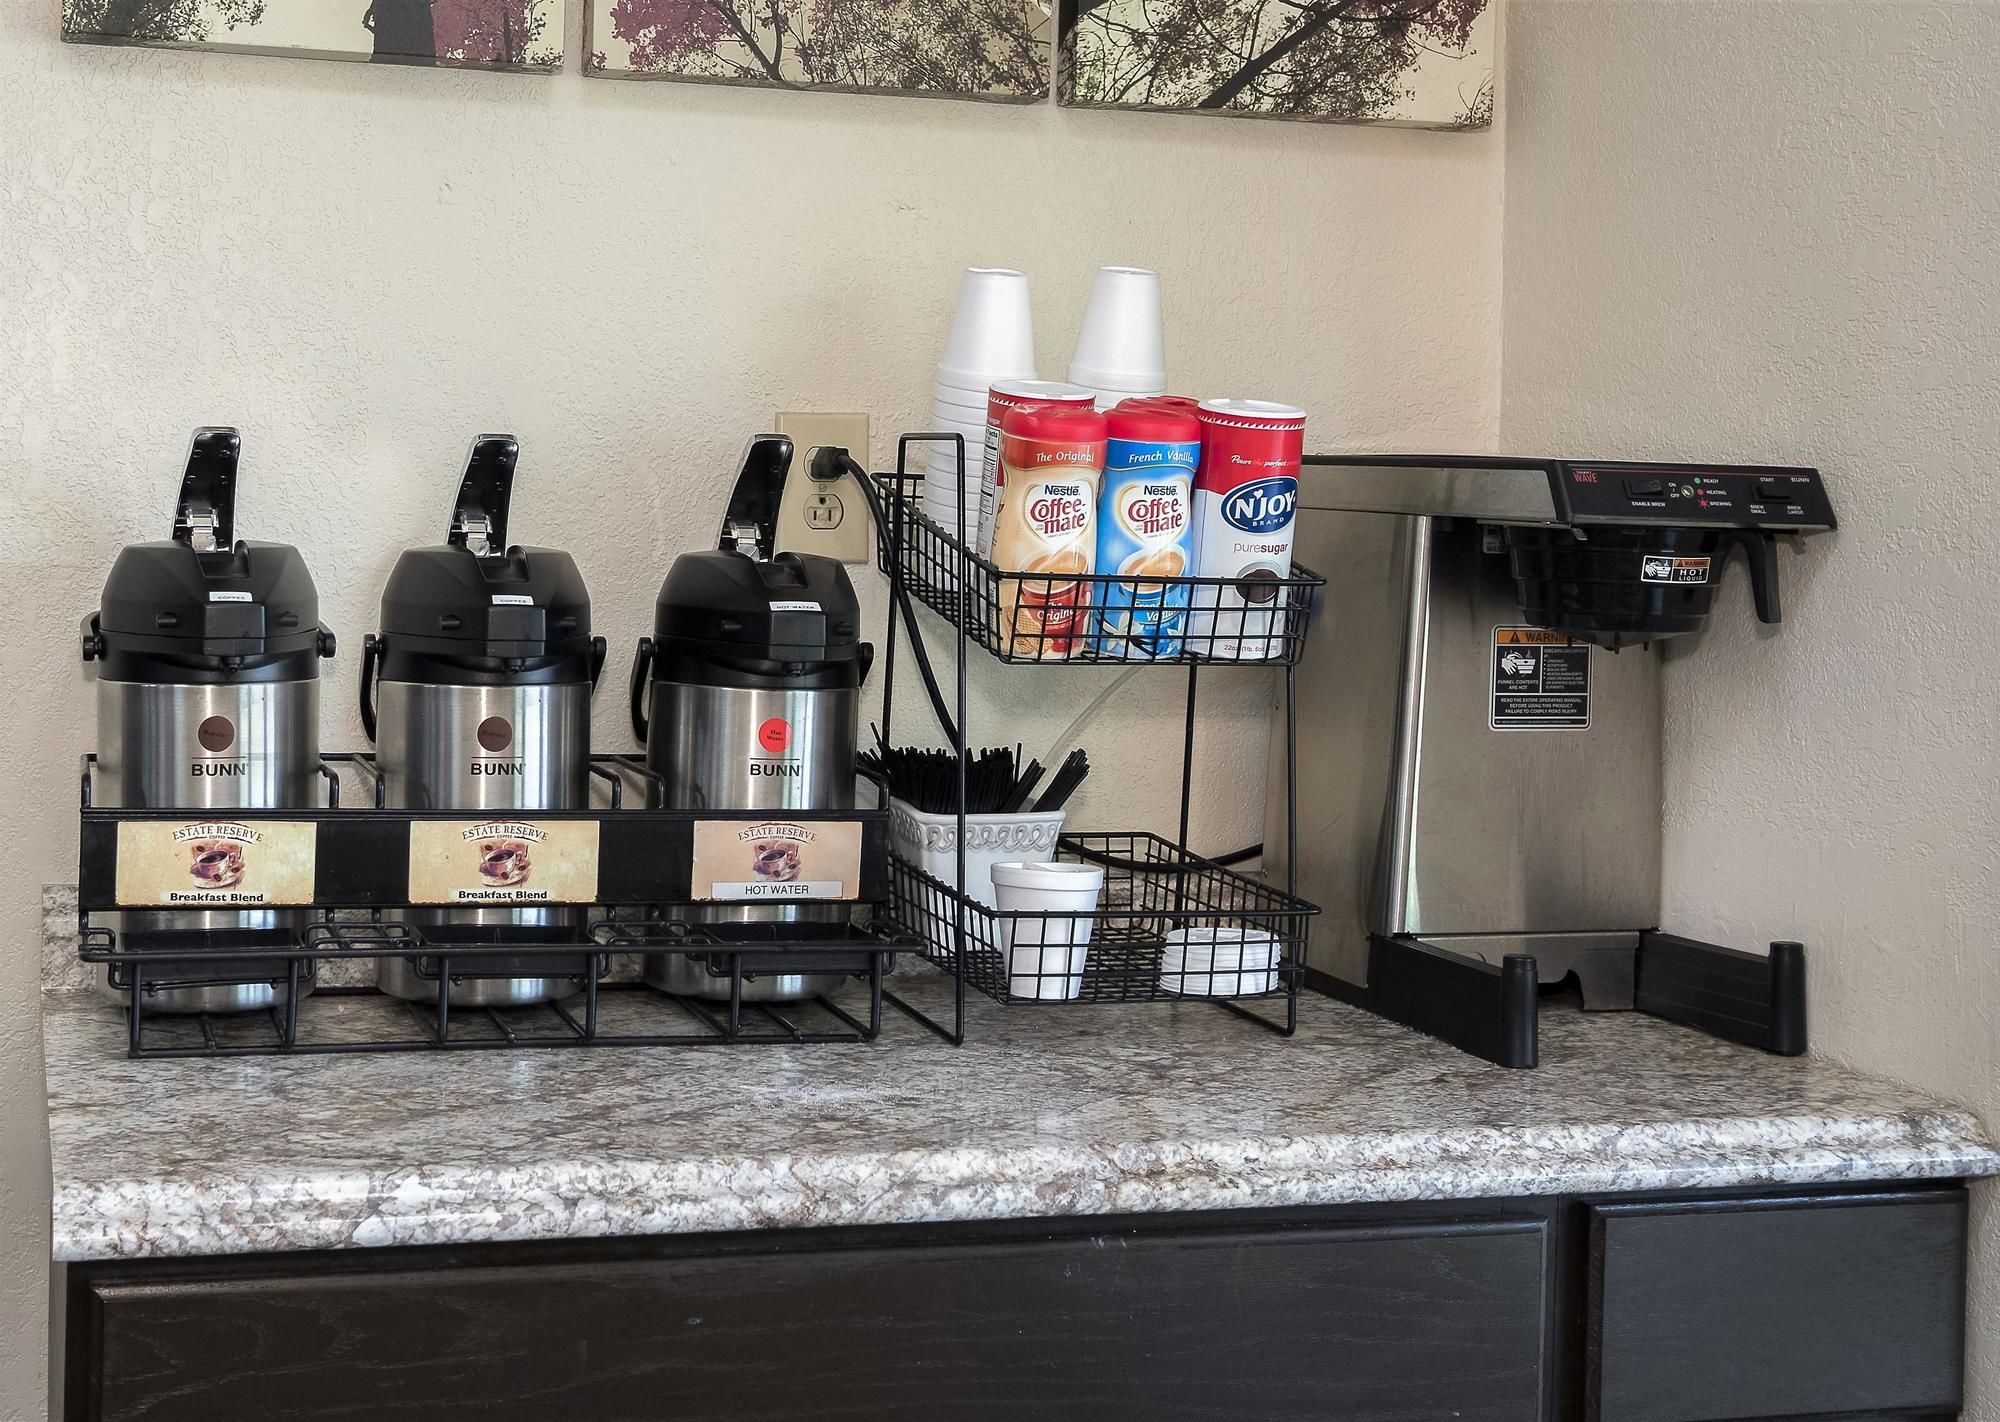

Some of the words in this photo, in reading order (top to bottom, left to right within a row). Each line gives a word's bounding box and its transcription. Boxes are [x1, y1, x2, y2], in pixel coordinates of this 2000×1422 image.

[1036, 453, 1053, 462] The
[1056, 451, 1095, 463] Original
[1128, 451, 1163, 463] French
[1167, 450, 1194, 464] Vanilla
[1230, 454, 1252, 465] Pours
[1263, 458, 1287, 468] perfect
[1572, 472, 1599, 483] WAVE
[1044, 513, 1085, 534] mate
[1143, 513, 1182, 534] mate
[1252, 517, 1284, 526] BRAND
[191, 763, 246, 777] BUNN
[471, 763, 523, 776] BUNN
[750, 763, 800, 777] BUNN
[172, 825, 213, 840] ESTATE
[216, 825, 264, 842] RESERVE
[462, 825, 501, 840] ESTATE
[504, 825, 549, 841] RESERVE
[738, 827, 774, 841] ESTATE
[776, 827, 818, 842] RESERVE
[170, 892, 227, 902] Breakfast
[230, 893, 264, 902] Blend
[458, 890, 513, 899] Breakfast
[515, 891, 548, 899] Blend
[745, 885, 768, 895] HOT
[771, 885, 809, 895] WATER
